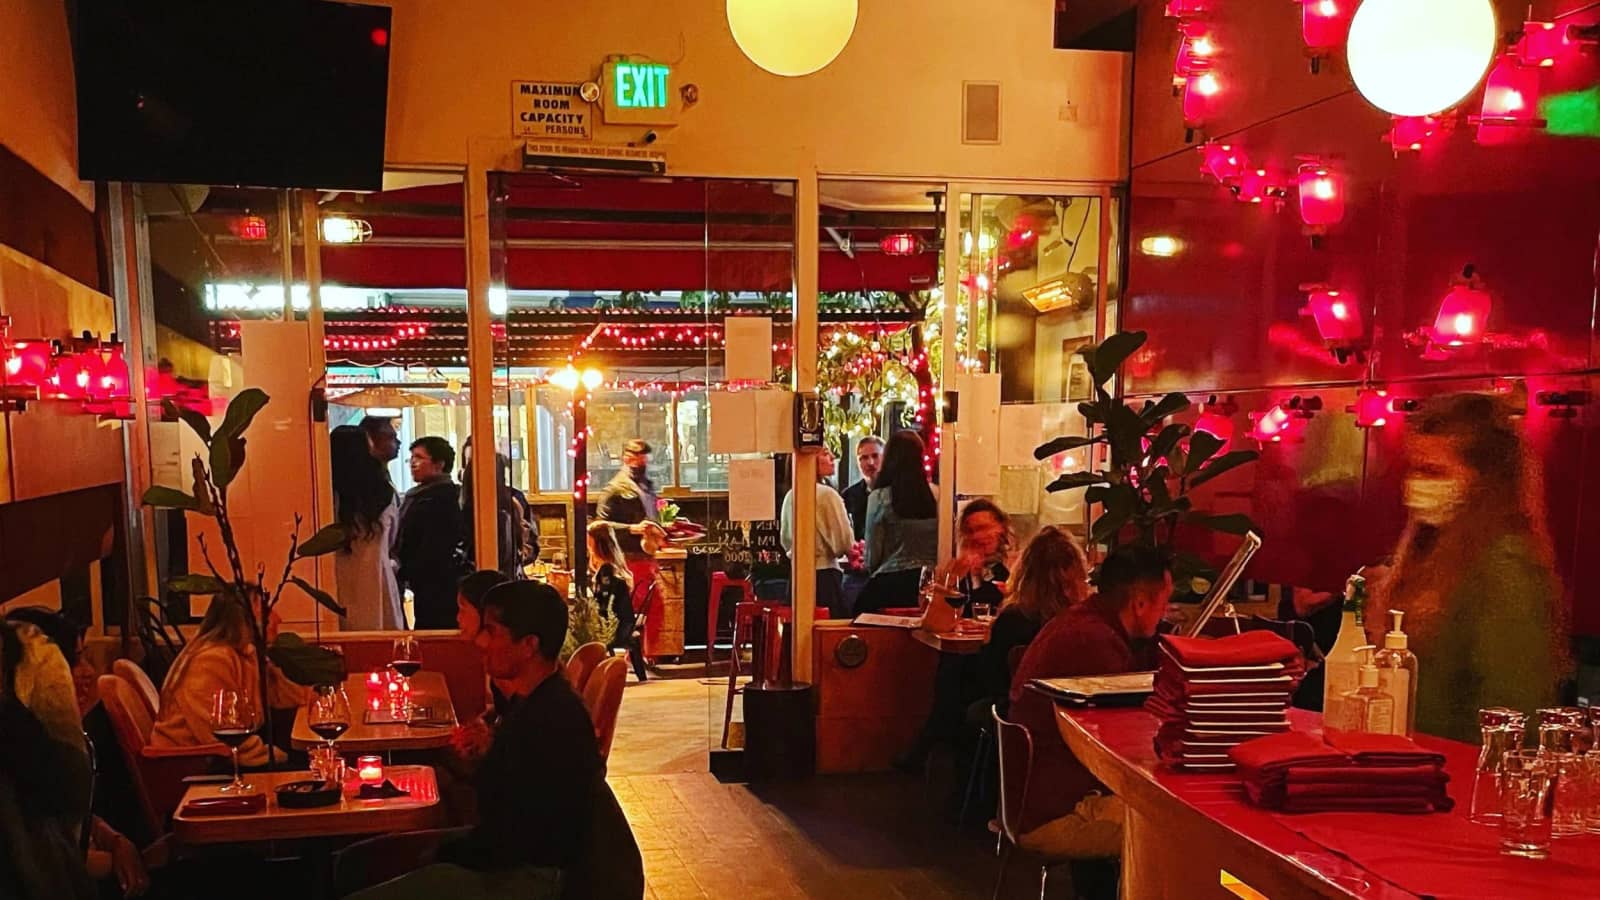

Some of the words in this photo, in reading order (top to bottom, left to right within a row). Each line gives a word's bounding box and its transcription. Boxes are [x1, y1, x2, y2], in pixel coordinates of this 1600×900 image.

[616, 64, 669, 107] EXIT
[533, 99, 570, 110] ROOM
[520, 112, 584, 124] CAPACITY
[545, 125, 586, 135] PERSONS
